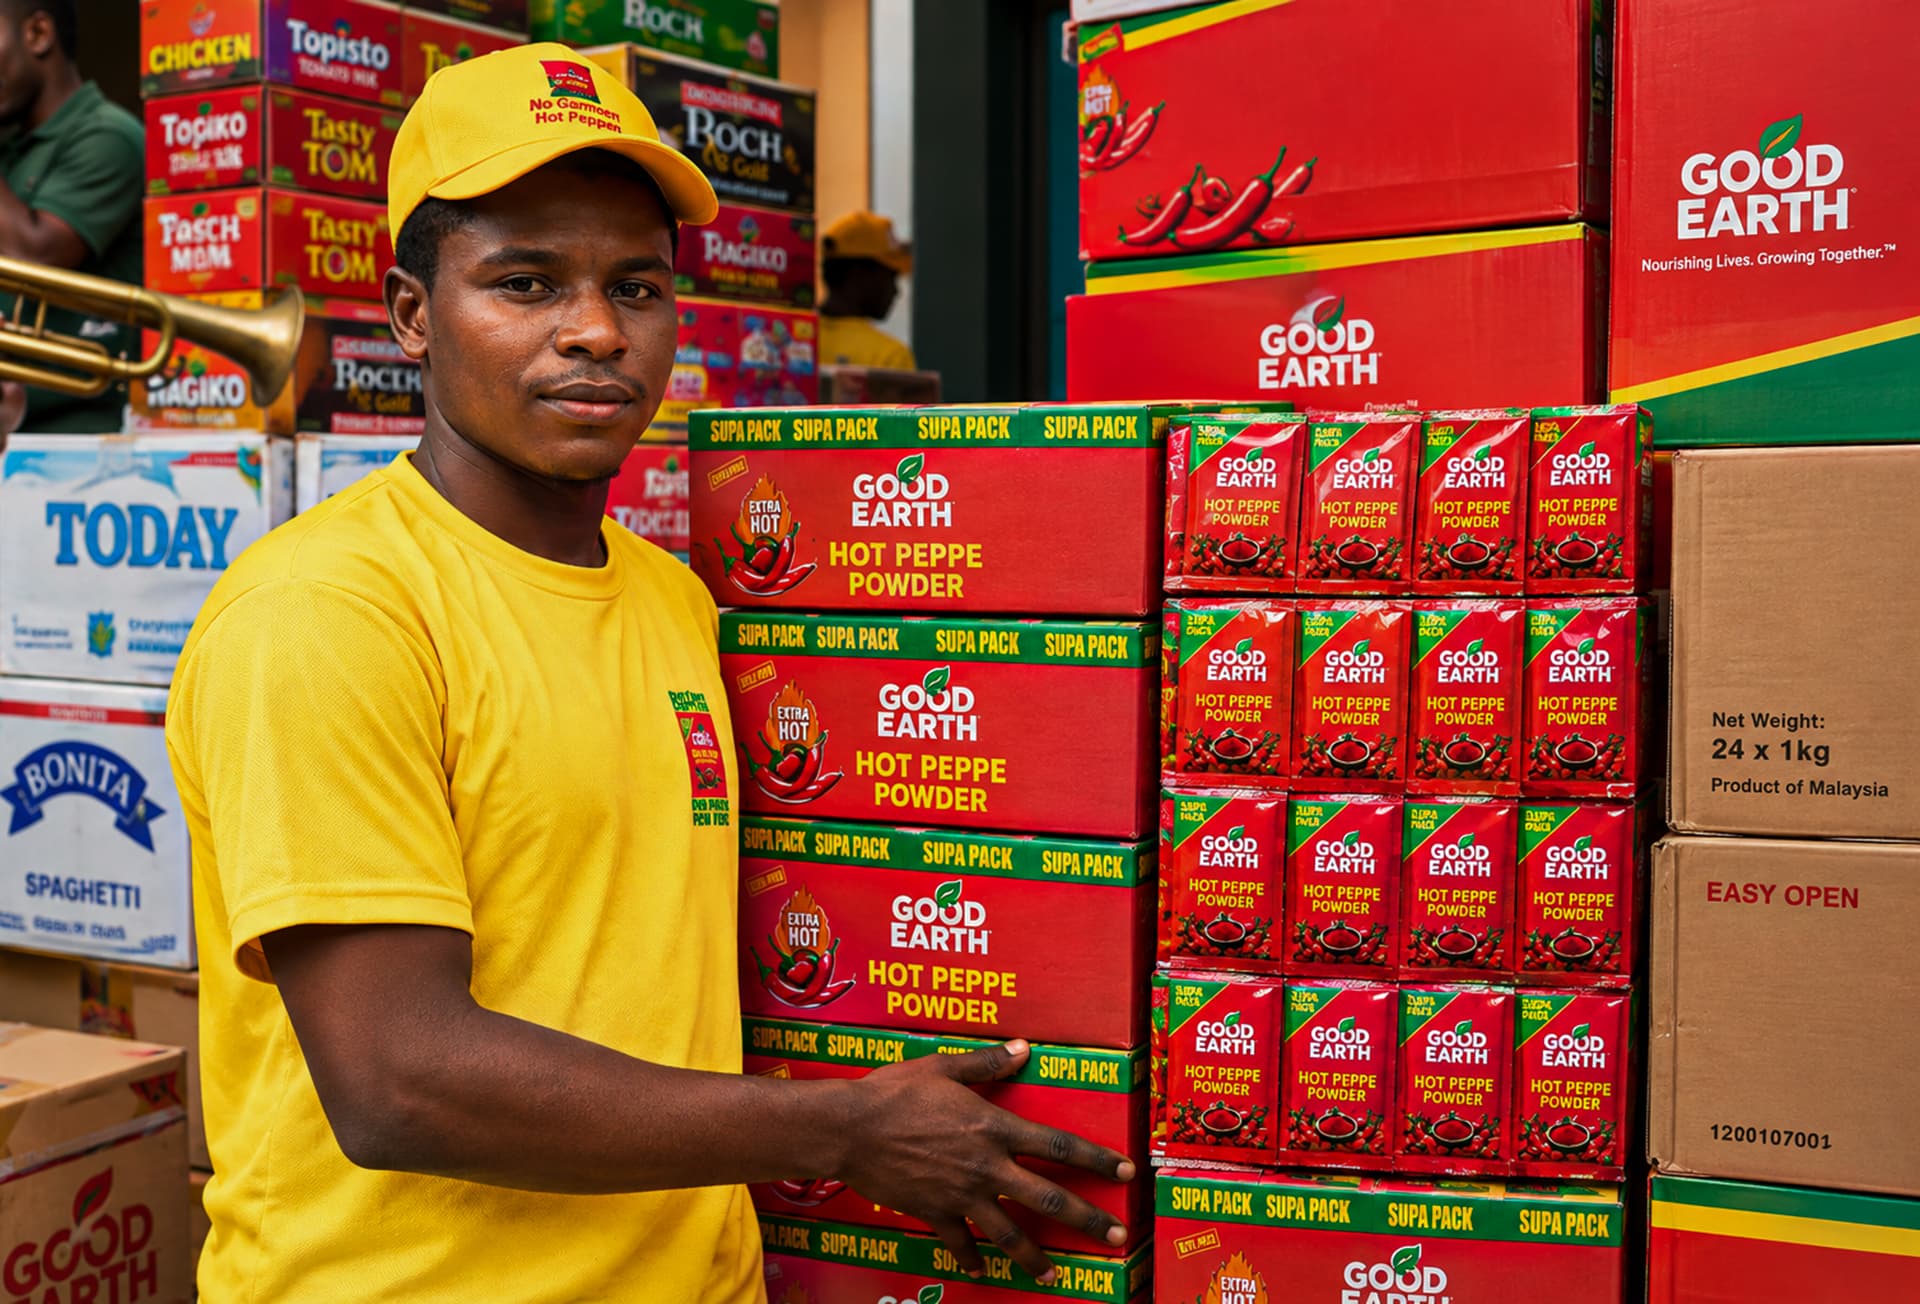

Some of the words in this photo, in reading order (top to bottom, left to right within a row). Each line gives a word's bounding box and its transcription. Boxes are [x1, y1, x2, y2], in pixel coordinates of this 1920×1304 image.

[150, 33, 252, 74] CHICKEN
[286, 18, 390, 70] Topisto
[529, 98, 553, 112] No
[535, 112, 564, 125] Hot
[302, 141, 378, 185] TOM
[1681, 144, 1844, 195] GOOD
[1677, 188, 1849, 240] EARTH
[304, 245, 378, 284] TOM
[1641, 255, 1713, 273] Nourishing
[1716, 253, 1754, 269] Lives.
[1757, 250, 1815, 266] Growing
[1260, 319, 1375, 357] GOOD
[1258, 353, 1378, 389] EARTH
[710, 420, 744, 442] SUPA
[747, 419, 782, 441] PACK
[793, 418, 833, 441] SUPA
[836, 417, 878, 440] PACK
[918, 416, 961, 439] SUPA
[965, 416, 1011, 439] PACK
[1044, 416, 1089, 439] SUPA
[1092, 416, 1138, 439] PACK
[1219, 457, 1276, 473] GOOD
[1552, 453, 1610, 469] GOOD
[853, 473, 949, 500] GOOD
[1216, 472, 1277, 488] EARTH
[1550, 469, 1611, 486] EARTH
[749, 500, 781, 514] EXTRA
[852, 502, 951, 527] EARTH
[1204, 499, 1233, 513] HOT
[1238, 499, 1280, 514] PEPPE
[1539, 499, 1568, 513] HOT
[1573, 498, 1617, 512] PEPPE
[751, 514, 781, 535] HOT
[1212, 513, 1269, 527] POWDER
[1548, 513, 1607, 527] POWDER
[46, 501, 239, 570] TODAY
[829, 541, 886, 566] HOT
[896, 542, 983, 568] PEPPE
[849, 572, 964, 598] POWDER
[738, 624, 770, 646] SUPA
[772, 624, 805, 647] PACK
[817, 626, 854, 649] SUPA
[858, 627, 899, 650] PACK
[936, 629, 976, 653] SUPA
[979, 630, 1020, 655] PACK
[1045, 633, 1086, 657] SUPA
[1088, 634, 1129, 659] PACK
[1325, 650, 1383, 667] GOOD
[1439, 650, 1498, 667] GOOD
[1324, 667, 1385, 683] EARTH
[1437, 667, 1499, 683] EARTH
[879, 683, 975, 713] GOOD
[1312, 696, 1342, 710] HOT
[1346, 697, 1391, 711] PEPPE
[1427, 696, 1457, 710] HOT
[1461, 697, 1505, 711] PEPPE
[777, 706, 809, 720] EXTRA
[1321, 711, 1380, 725] POWDER
[1435, 712, 1494, 725] POWDER
[1712, 712, 1744, 728] Net
[1751, 713, 1825, 732] Weight:
[779, 721, 810, 741] HOT
[878, 711, 977, 741] EARTH
[1711, 738, 1744, 760] 24
[1753, 744, 1769, 760] x
[1780, 739, 1830, 767] 1kg
[856, 750, 912, 777] HOT
[921, 754, 1007, 784] PEPPE
[23, 751, 130, 809] BONITA
[1711, 778, 1780, 794] Product
[1785, 780, 1804, 795] of
[1809, 780, 1889, 800] Malaysia
[875, 782, 988, 812] POWDER
[745, 827, 774, 850] SUPA
[775, 829, 806, 853] PACK
[815, 832, 850, 857] SUPA
[852, 834, 890, 860] PACK
[922, 840, 966, 866] SUPA
[969, 845, 1013, 870] PACK
[1042, 850, 1081, 876] SUPA
[1084, 854, 1124, 879] PACK
[1201, 835, 1257, 852] GOOD
[1199, 851, 1258, 869] EARTH
[1546, 846, 1606, 863] GOOD
[1544, 862, 1608, 879] EARTH
[25, 871, 141, 910] SPAGHETTI
[1189, 879, 1218, 893] HOT
[1222, 880, 1265, 896] PEPPE
[1707, 882, 1777, 904] EASY
[1784, 885, 1859, 909] OPEN
[1197, 894, 1254, 909] POWDER
[1534, 891, 1564, 905] HOT
[1569, 892, 1614, 907] PEPPE
[787, 912, 820, 926] EXTRA
[892, 895, 986, 927] GOOD
[1543, 907, 1603, 921] POWDER
[788, 927, 820, 947] HOT
[890, 922, 989, 955] EARTH
[868, 960, 923, 986] HOT
[932, 966, 1017, 997] PEPPE
[887, 991, 998, 1024] POWDER
[1427, 1030, 1486, 1047] GOOD
[752, 1026, 783, 1049] SUPA
[785, 1029, 818, 1054] PACK
[828, 1034, 862, 1059] SUPA
[867, 1037, 905, 1062] PACK
[1039, 1055, 1077, 1081] SUPA
[1080, 1059, 1119, 1085] PACK
[1425, 1046, 1488, 1065] EARTH
[1414, 1075, 1446, 1090] HOT
[1449, 1076, 1494, 1092] PEPPE
[1423, 1090, 1483, 1106] POWDER
[1710, 1124, 1832, 1150] 1200107001
[1172, 1186, 1210, 1213] SUPA
[1213, 1189, 1252, 1216] PACK
[1266, 1194, 1305, 1220] SUPA
[1309, 1197, 1350, 1224] PACK
[1388, 1202, 1428, 1229] SUPA
[1431, 1204, 1473, 1231] PACK
[1519, 1209, 1562, 1235] SUPA
[1565, 1211, 1609, 1238] PACK
[3, 1203, 153, 1296] GOOD
[778, 1226, 809, 1250] PACK
[821, 1231, 857, 1257] SUPA
[860, 1237, 899, 1263] PACK
[1075, 1267, 1114, 1295] PACK
[15, 1250, 157, 1304] RTH
[1220, 1276, 1256, 1292] EXTRA
[1343, 1261, 1447, 1294] GOOD
